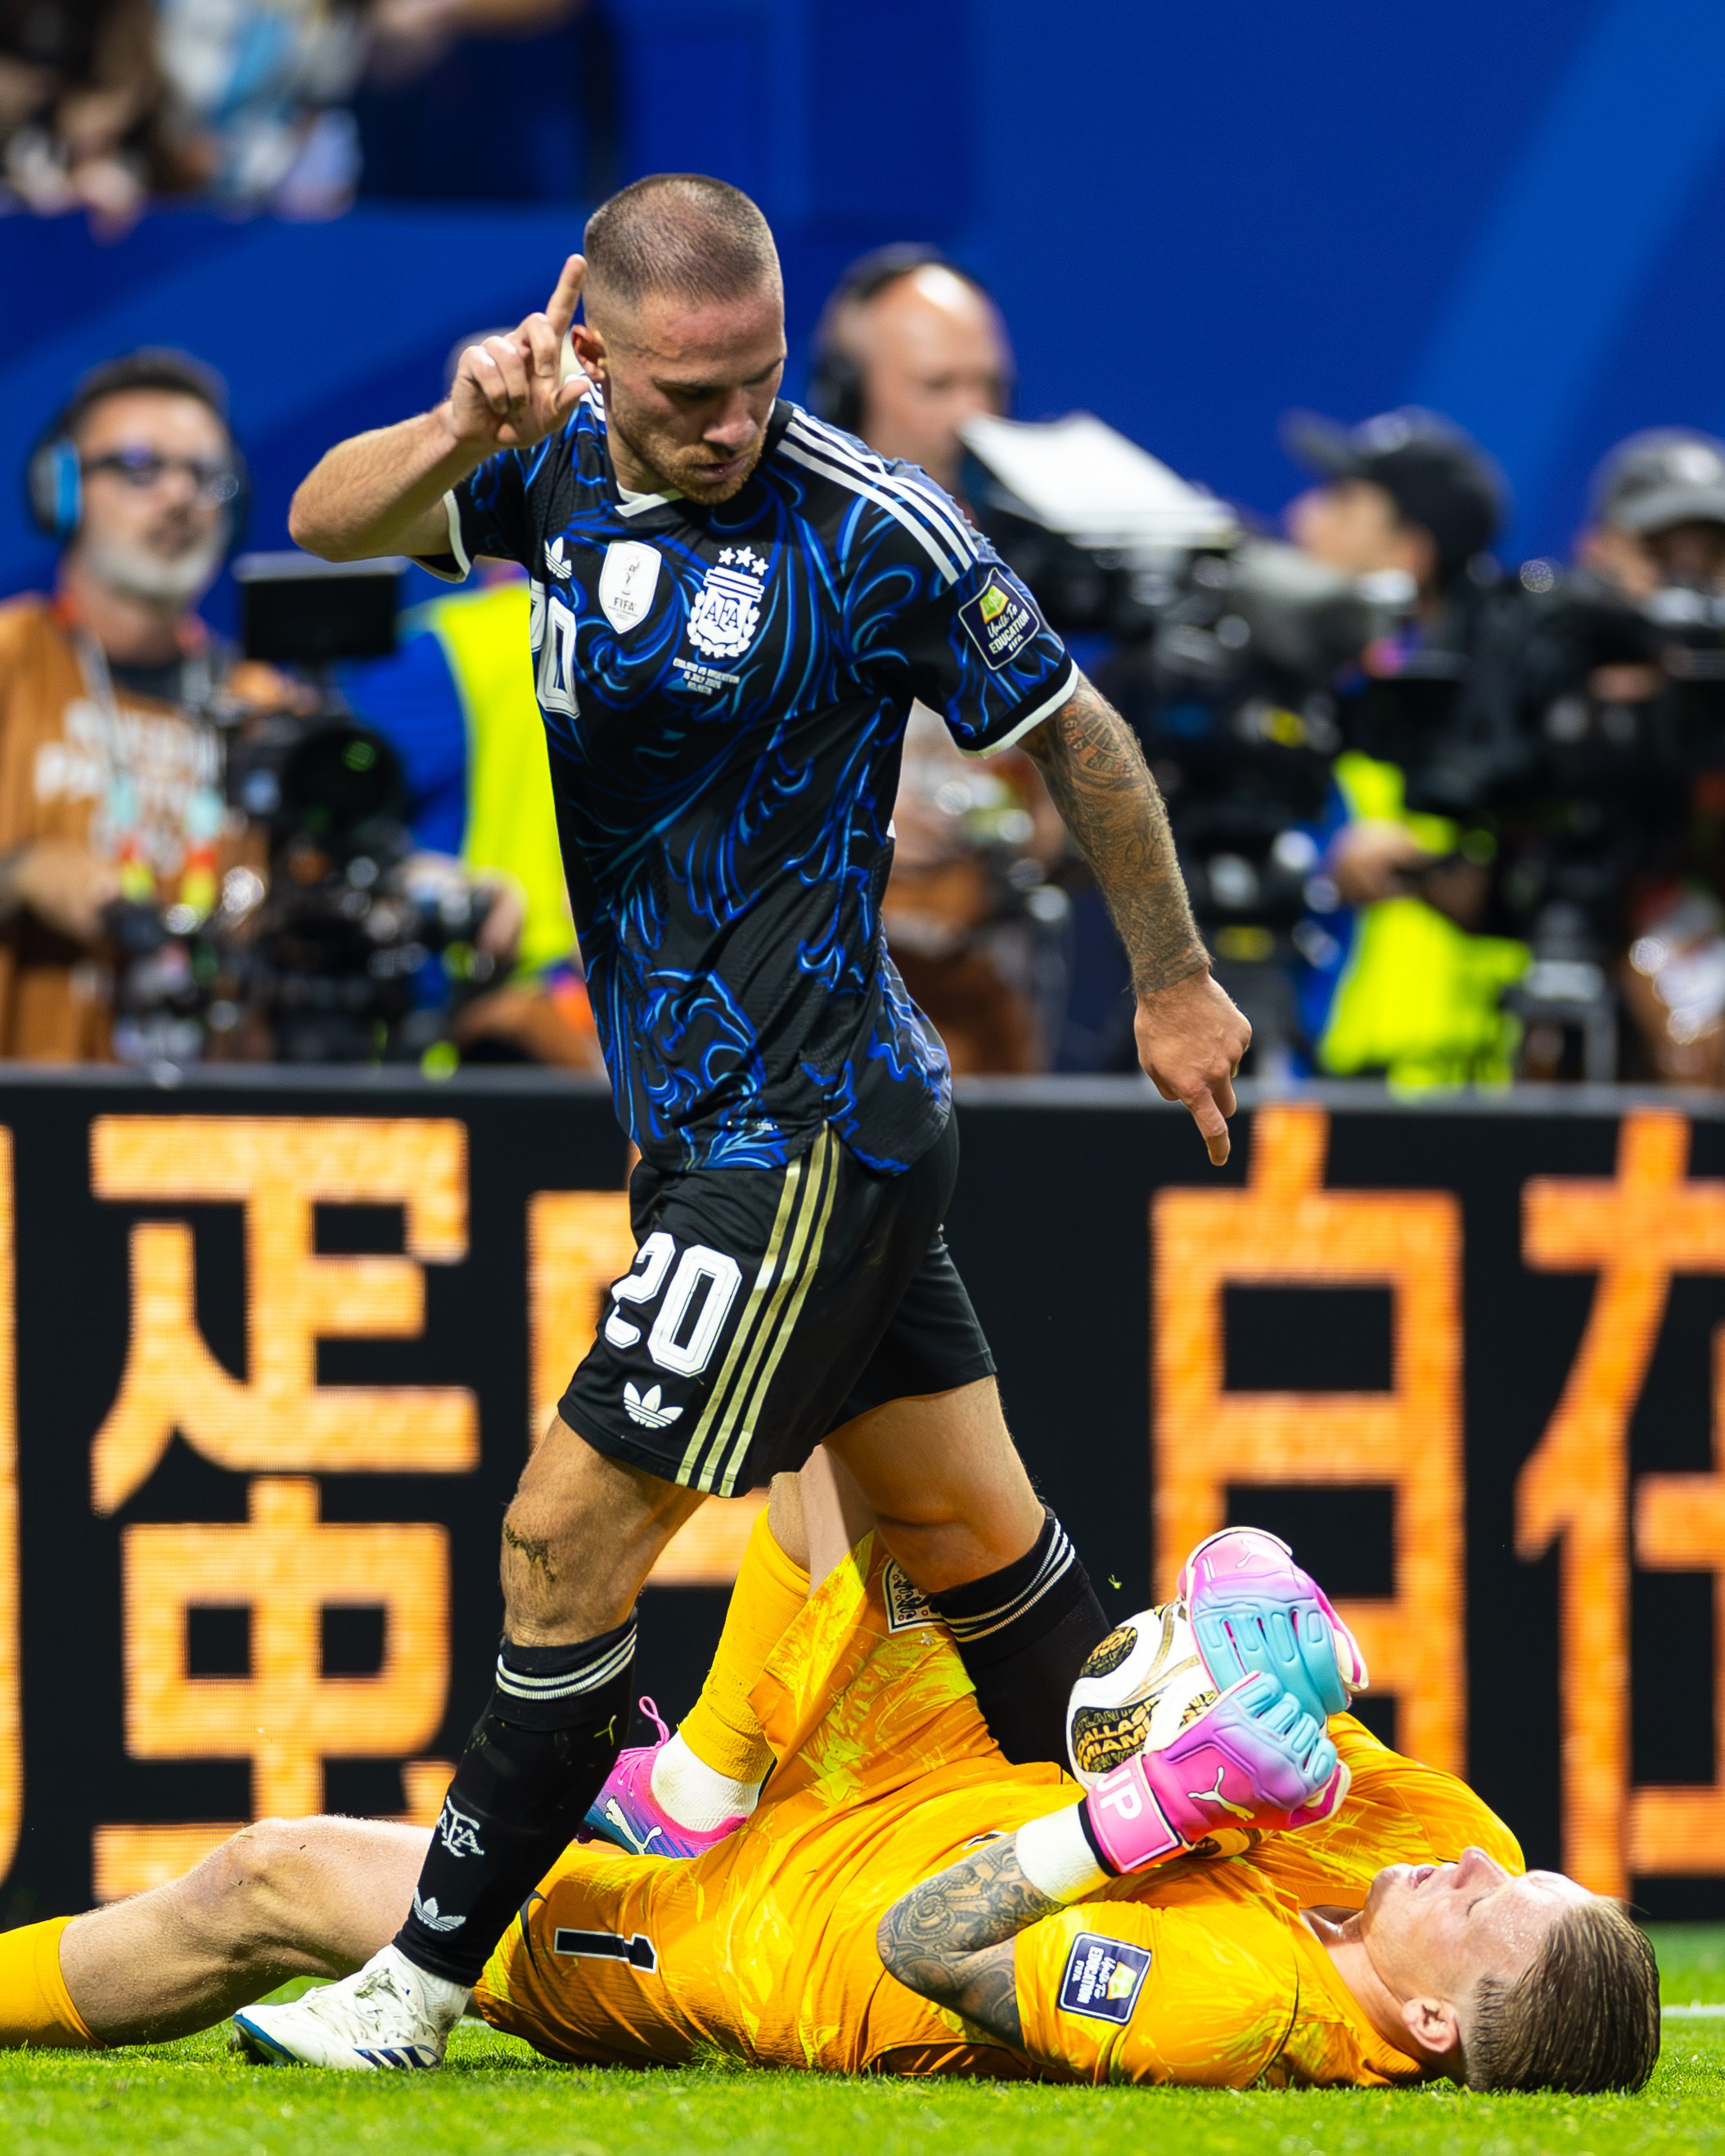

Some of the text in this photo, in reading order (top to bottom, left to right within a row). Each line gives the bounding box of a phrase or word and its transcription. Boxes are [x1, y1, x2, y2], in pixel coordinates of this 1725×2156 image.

[614, 597, 634, 611] FIFA
[704, 591, 741, 632] AFA
[989, 608, 1030, 655] EDUCATION
[1007, 634, 1024, 652] FIFA
[605, 1231, 743, 1378] 20
[1077, 1705, 1146, 1768] DALLAS
